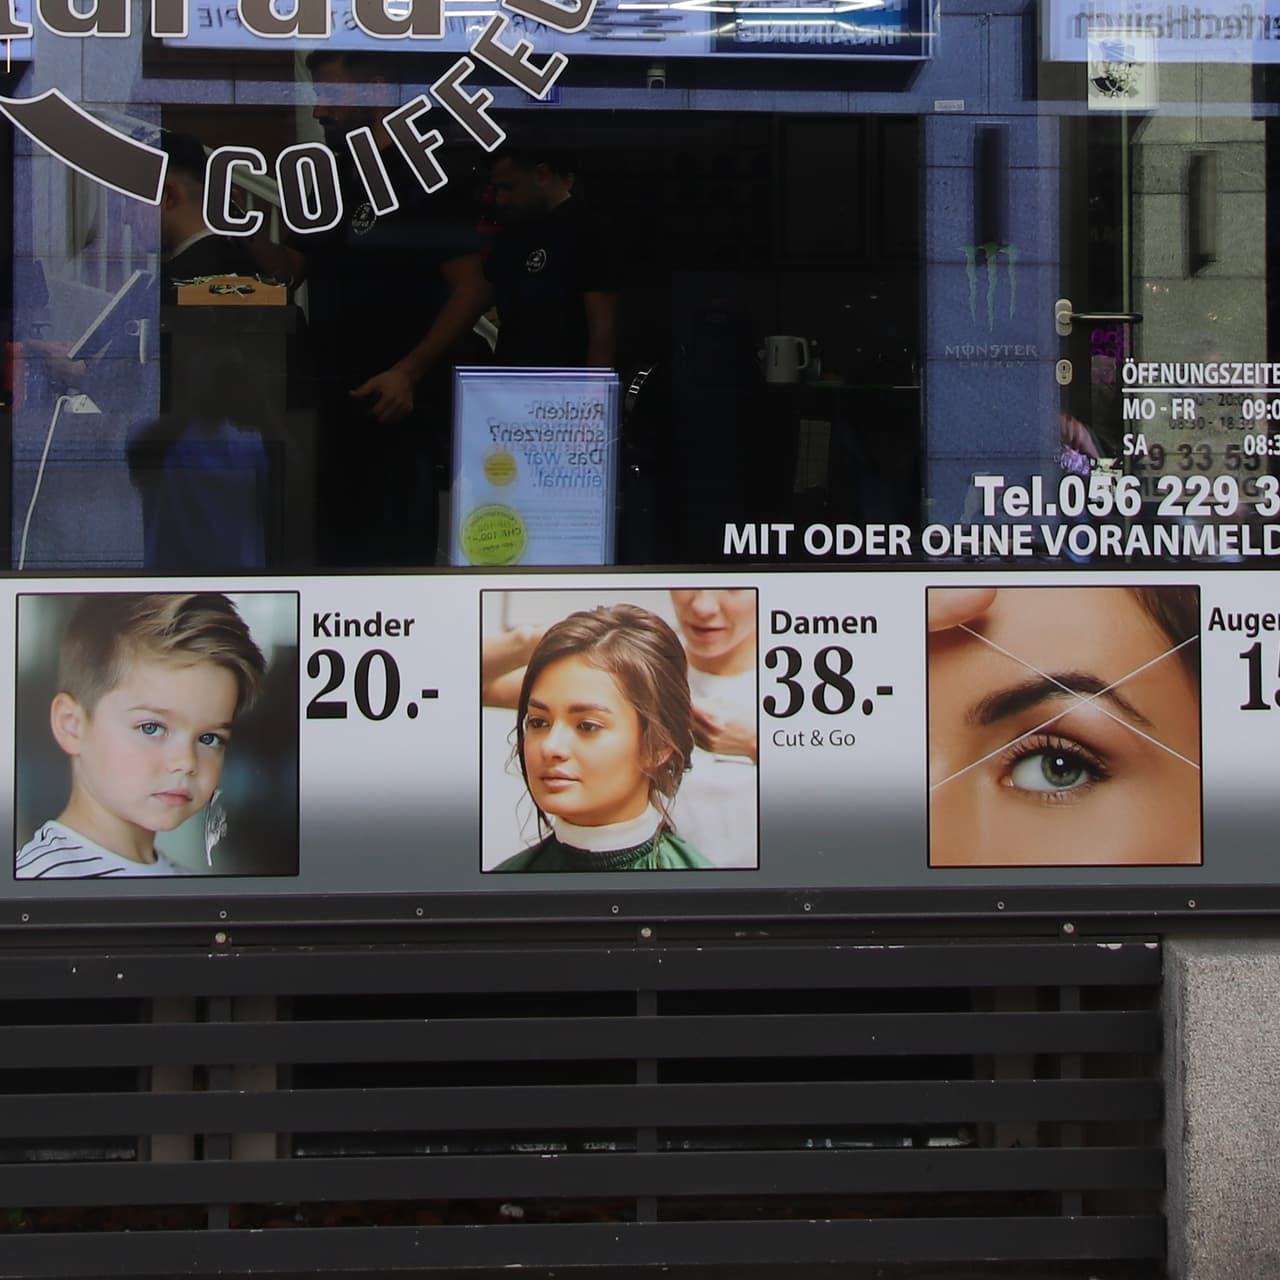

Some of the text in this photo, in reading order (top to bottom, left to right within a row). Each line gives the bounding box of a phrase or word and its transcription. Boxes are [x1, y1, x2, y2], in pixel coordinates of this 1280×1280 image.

[1122, 398, 1156, 420] MO
[1171, 398, 1196, 420] FR
[1122, 433, 1149, 456] SA
[974, 471, 1142, 517] Tel.056
[1156, 474, 1240, 517] 229
[723, 523, 795, 556] MIT
[804, 523, 913, 556] ODER
[921, 523, 1034, 557] OHNE
[312, 611, 416, 639] Kinder
[770, 609, 879, 636] Damen
[305, 648, 440, 722] 20.-
[762, 645, 895, 719] 38.-
[772, 728, 857, 748] Cut & Go
